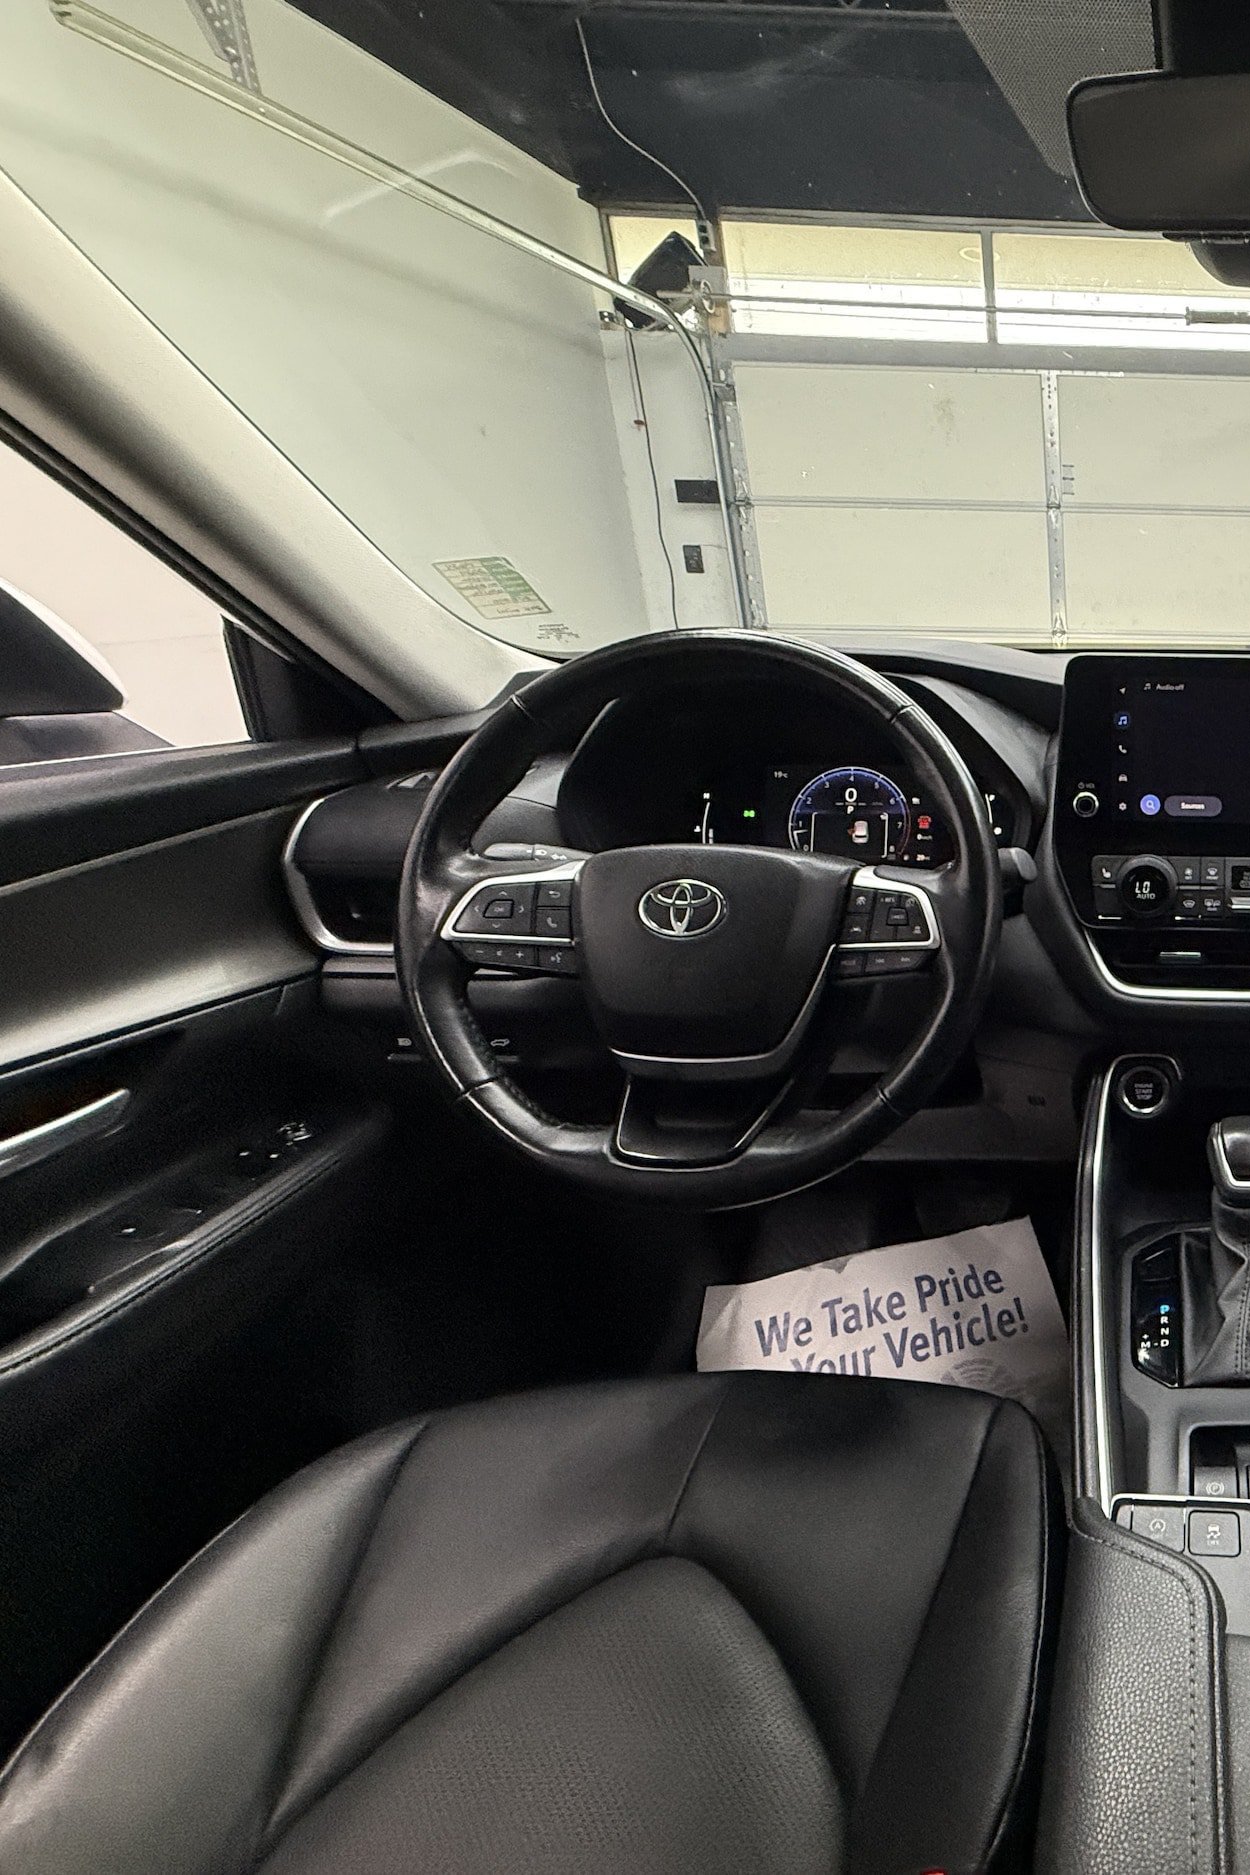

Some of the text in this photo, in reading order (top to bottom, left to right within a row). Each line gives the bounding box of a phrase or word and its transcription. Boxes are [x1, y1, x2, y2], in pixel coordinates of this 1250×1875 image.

[1156, 683, 1174, 691] Audio
[845, 787, 858, 803] 0
[1181, 802, 1205, 810] Sources
[1135, 881, 1151, 893] LO
[755, 1264, 1005, 1357] We Take Pride
[1160, 1304, 1170, 1315] P
[1160, 1315, 1169, 1325] R
[883, 1297, 1029, 1369] Vehicle!
[1160, 1327, 1170, 1336] N
[1140, 1341, 1151, 1349] M
[1160, 1338, 1170, 1348] D
